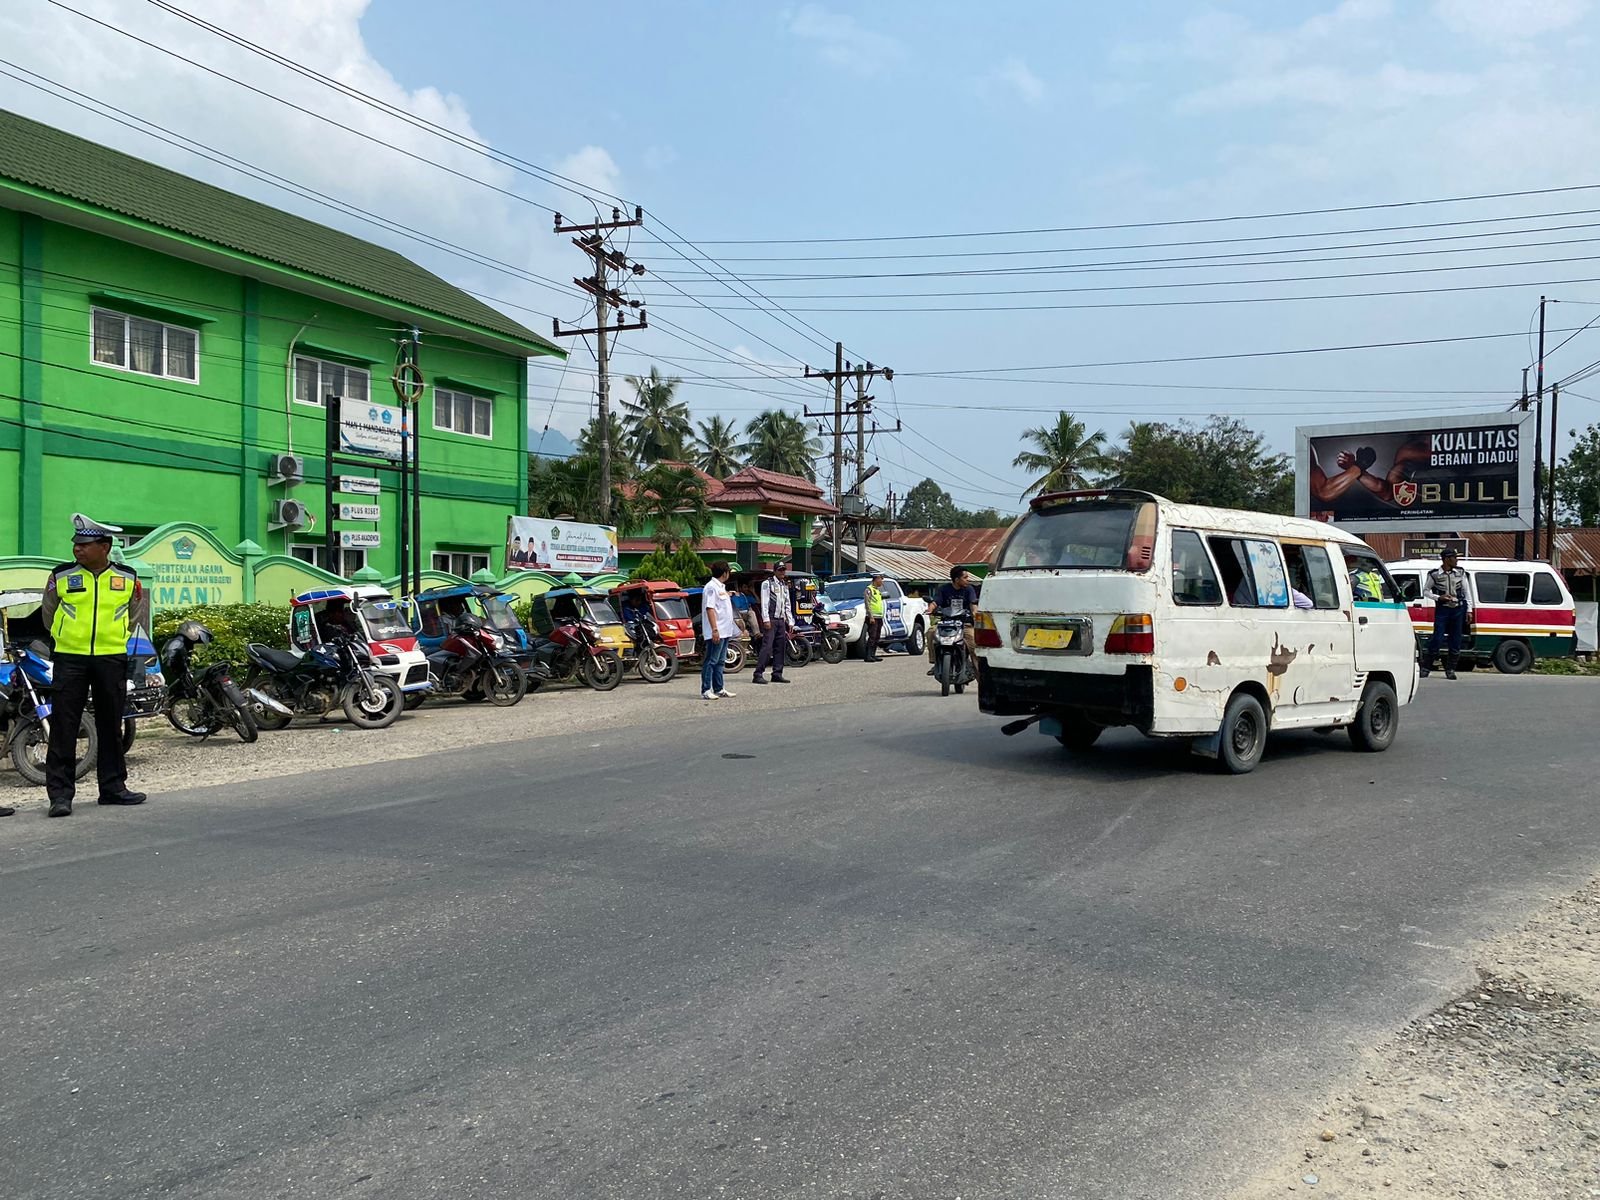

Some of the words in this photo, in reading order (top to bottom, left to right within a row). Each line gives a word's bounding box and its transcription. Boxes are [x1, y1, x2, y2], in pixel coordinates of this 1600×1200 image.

[1431, 429, 1518, 452] KUALITAS
[1430, 452, 1473, 466] BERANI
[1477, 449, 1519, 464] DIADU!
[1421, 480, 1519, 503] BULL
[351, 506, 364, 515] PLUS
[364, 507, 379, 515] RISET
[151, 563, 197, 574] EMENTERIAN
